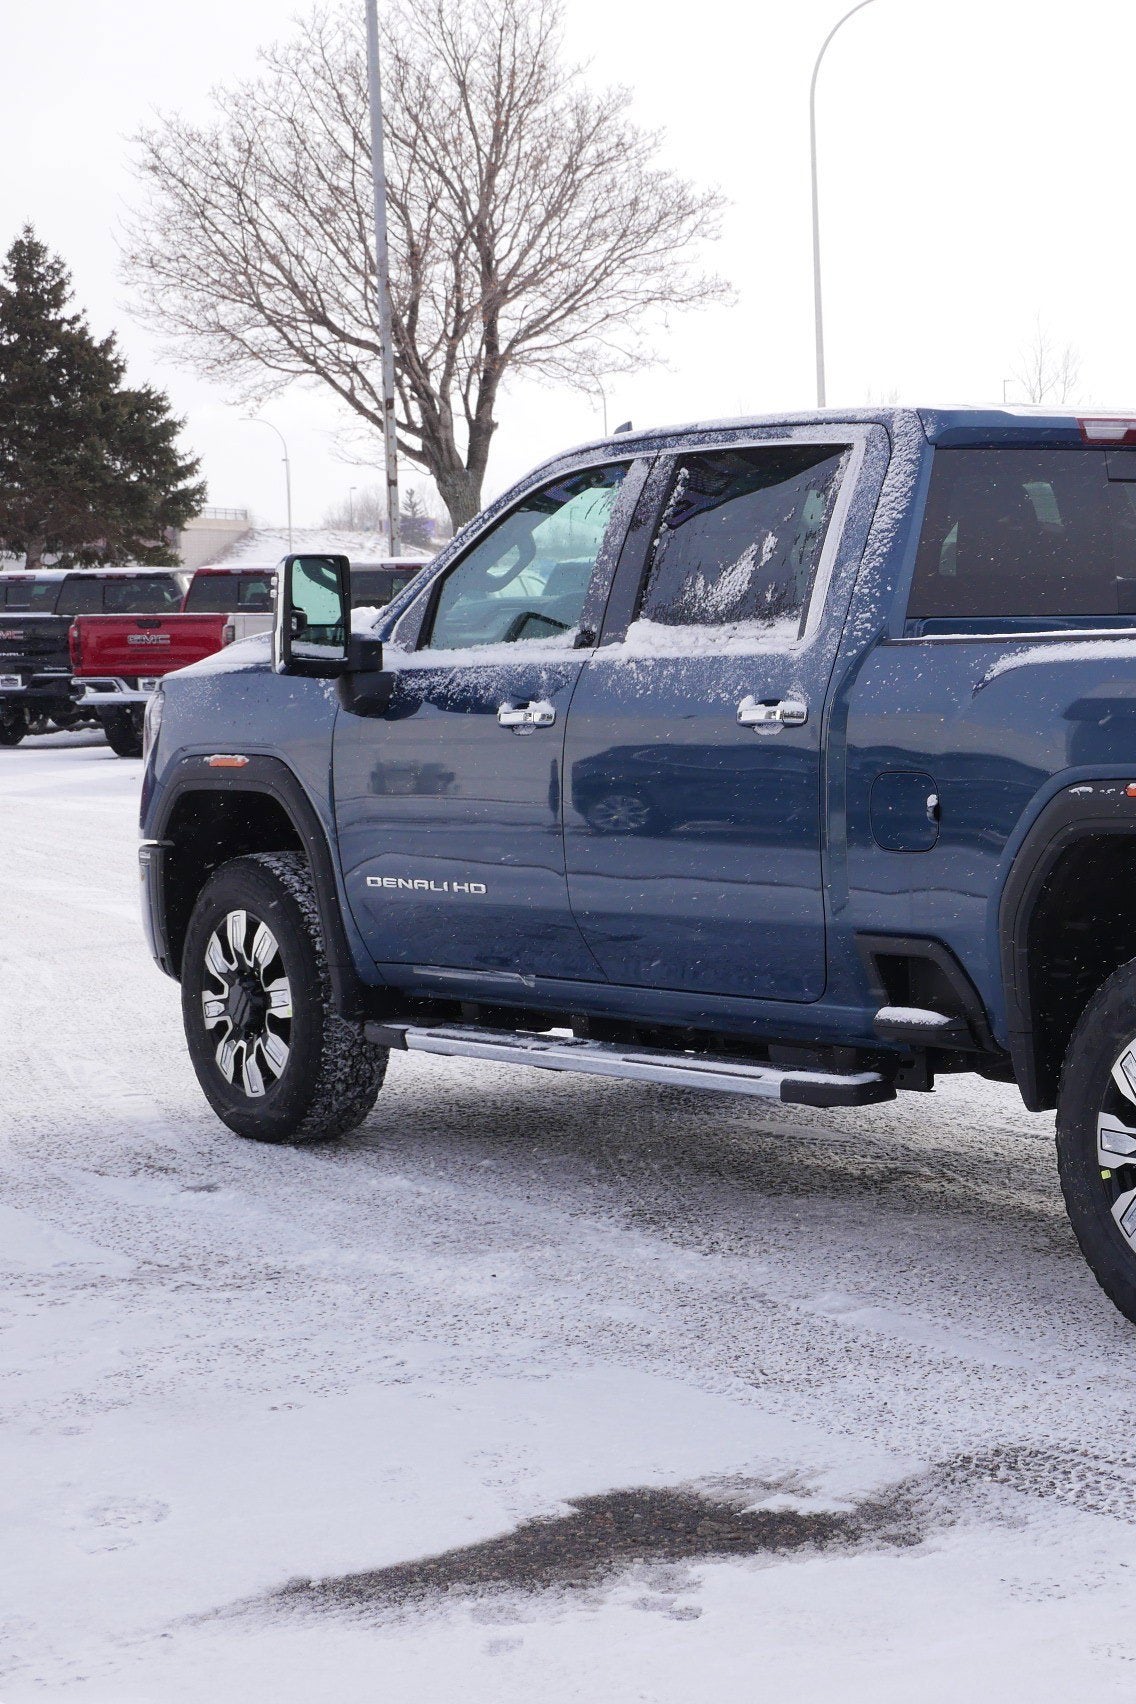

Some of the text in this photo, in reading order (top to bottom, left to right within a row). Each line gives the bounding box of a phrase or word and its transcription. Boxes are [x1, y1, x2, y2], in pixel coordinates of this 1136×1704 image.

[127, 634, 171, 645] GMC
[366, 876, 487, 894] DENALI HD
